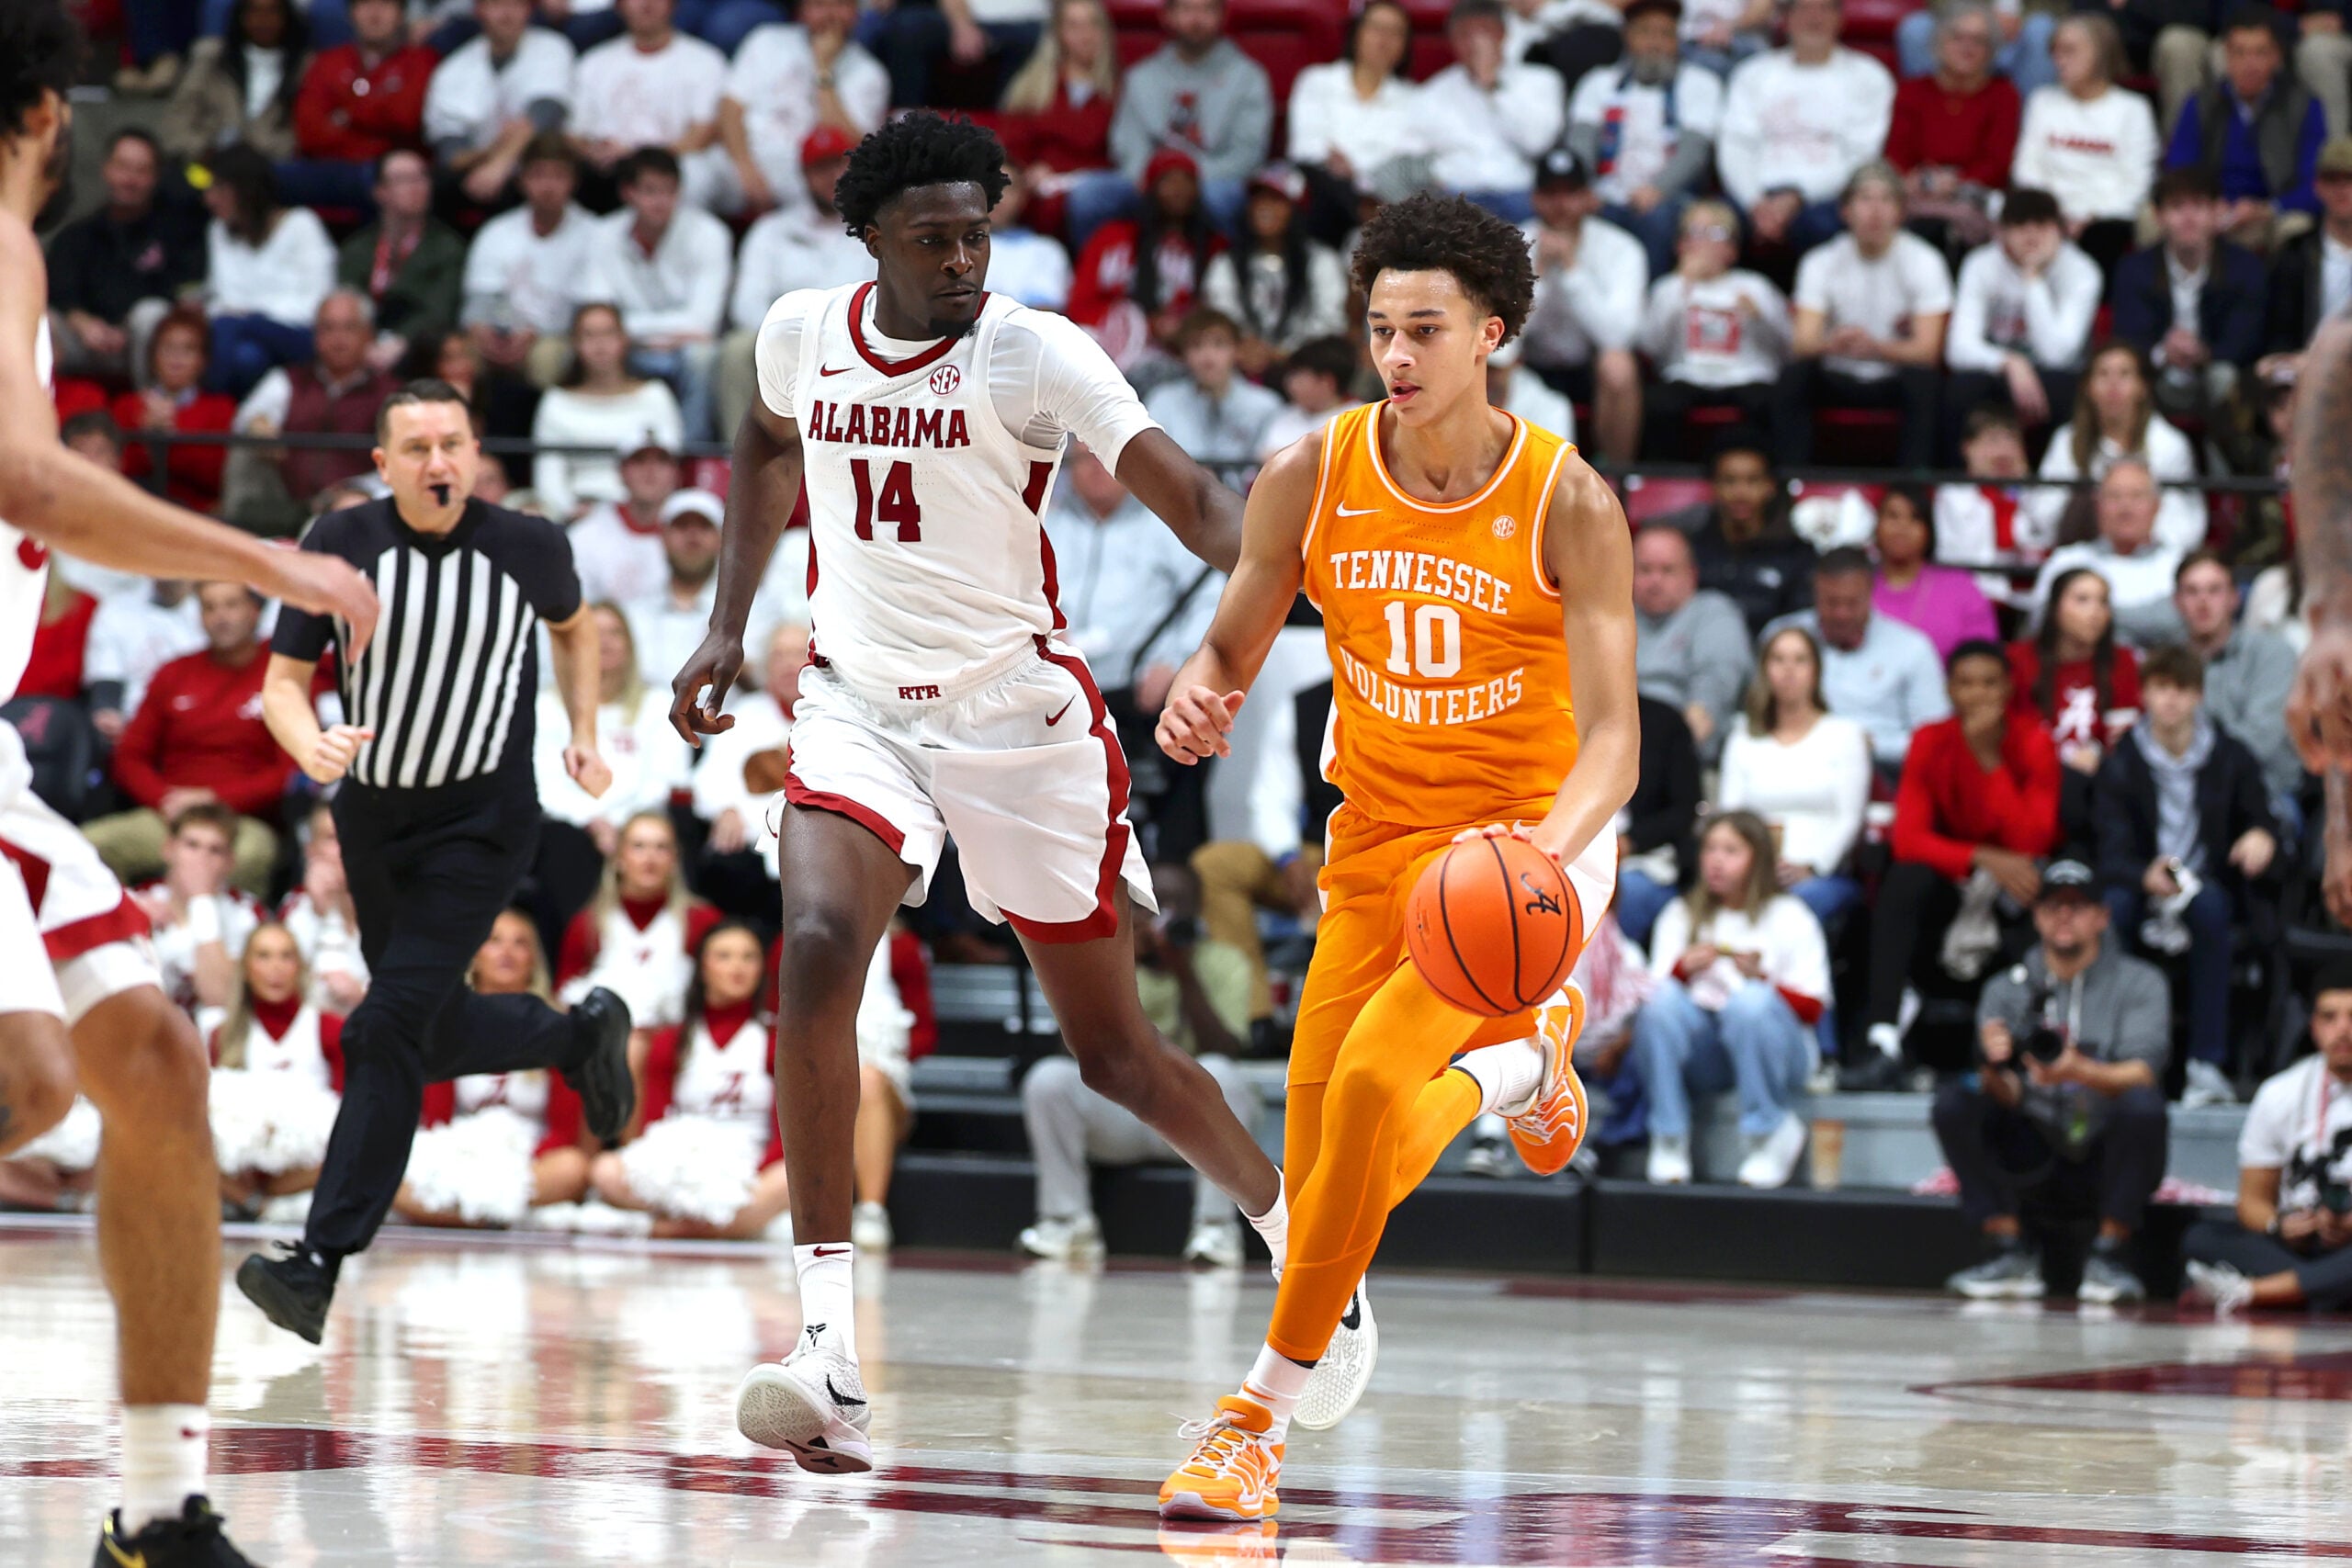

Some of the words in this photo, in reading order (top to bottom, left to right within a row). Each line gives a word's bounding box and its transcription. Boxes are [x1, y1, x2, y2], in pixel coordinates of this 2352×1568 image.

[931, 365, 960, 395] SEC
[808, 400, 970, 448] ALABAMA
[850, 458, 922, 542] 14
[1493, 516, 1515, 538] SEC
[1330, 550, 1511, 615] TENNESSEE
[1384, 601, 1461, 678] 10
[898, 684, 942, 701] RTR
[1339, 645, 1525, 725] VOLUNTEERS
